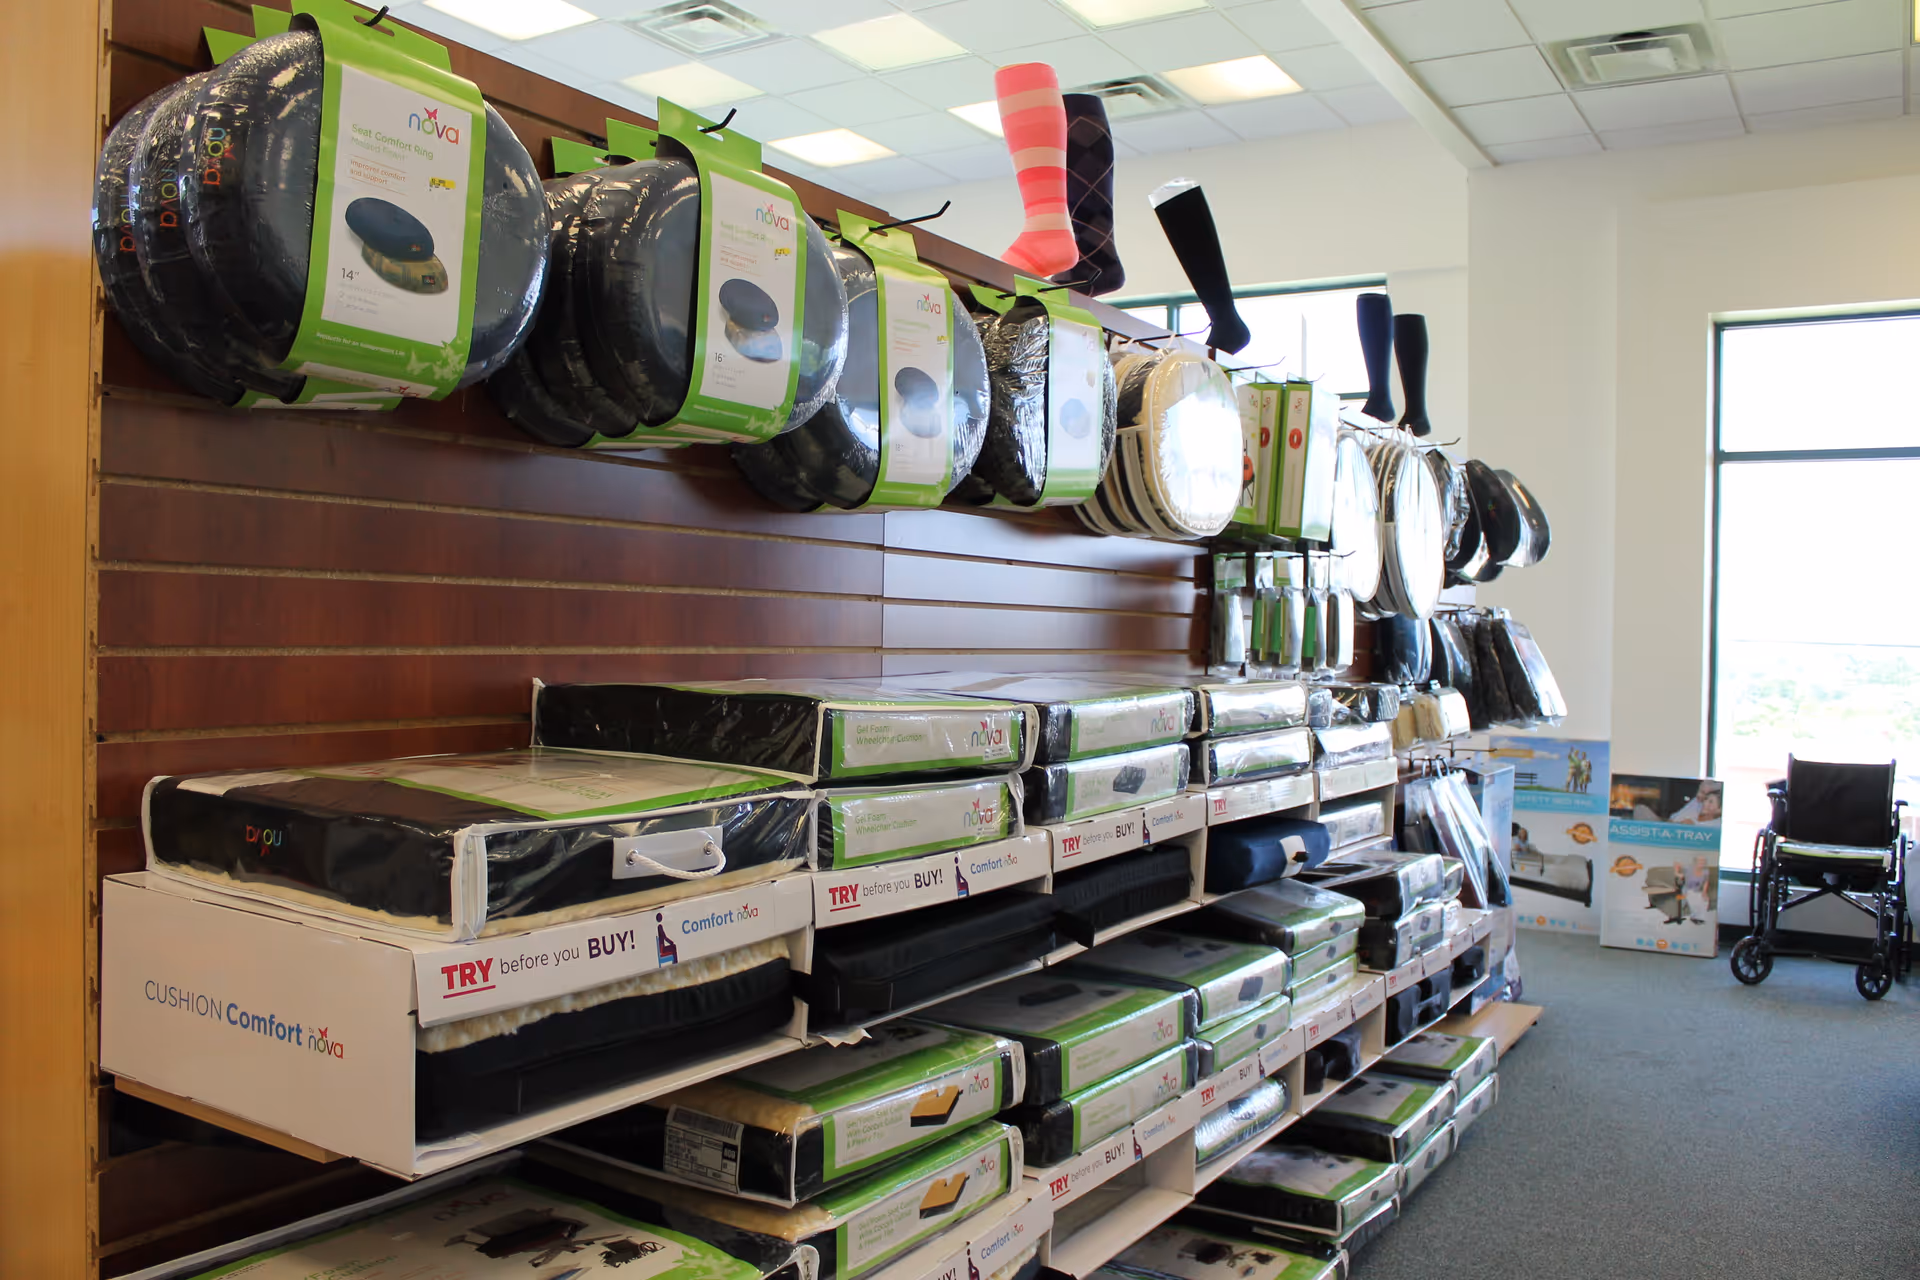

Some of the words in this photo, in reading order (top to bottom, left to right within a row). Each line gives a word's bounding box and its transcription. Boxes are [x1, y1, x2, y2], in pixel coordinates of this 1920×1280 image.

[408, 111, 460, 145] nova
[351, 123, 372, 139] Seat
[374, 131, 412, 152] Comfort
[414, 144, 434, 161] Ring
[202, 127, 227, 186] nova
[160, 168, 181, 228] nova
[755, 207, 790, 232] nova
[916, 299, 942, 315] nova
[857, 724, 869, 735] Gel
[870, 724, 891, 735] Foam
[1151, 715, 1175, 734] nova
[971, 729, 1003, 748] nova
[963, 807, 994, 828] nova
[1214, 799, 1227, 813] TRY
[855, 814, 867, 825] Gel
[868, 812, 887, 823] Foam
[1152, 814, 1174, 827] Comfort
[1062, 836, 1081, 853] TRY
[1083, 833, 1102, 846] before
[1116, 822, 1136, 839] BUY!
[970, 857, 1003, 875] Comfort
[828, 883, 860, 907] TRY
[862, 882, 892, 898] before
[893, 879, 910, 893] you
[914, 868, 943, 889] BUY!
[681, 909, 734, 935] Comfort
[736, 907, 758, 922] nova
[441, 957, 494, 990] TRY
[500, 953, 549, 975] before
[553, 945, 580, 967] you
[588, 929, 636, 959] BUY!
[145, 980, 222, 1021] CUSHION
[226, 1002, 303, 1046] Comfort
[308, 1034, 344, 1060] nova
[968, 1077, 990, 1096] nova
[1201, 1085, 1215, 1103] TRY
[975, 1160, 996, 1178] nova
[1049, 1174, 1069, 1197] TRY
[1105, 1142, 1126, 1165] BUY!
[981, 1232, 1010, 1260] Comfort
